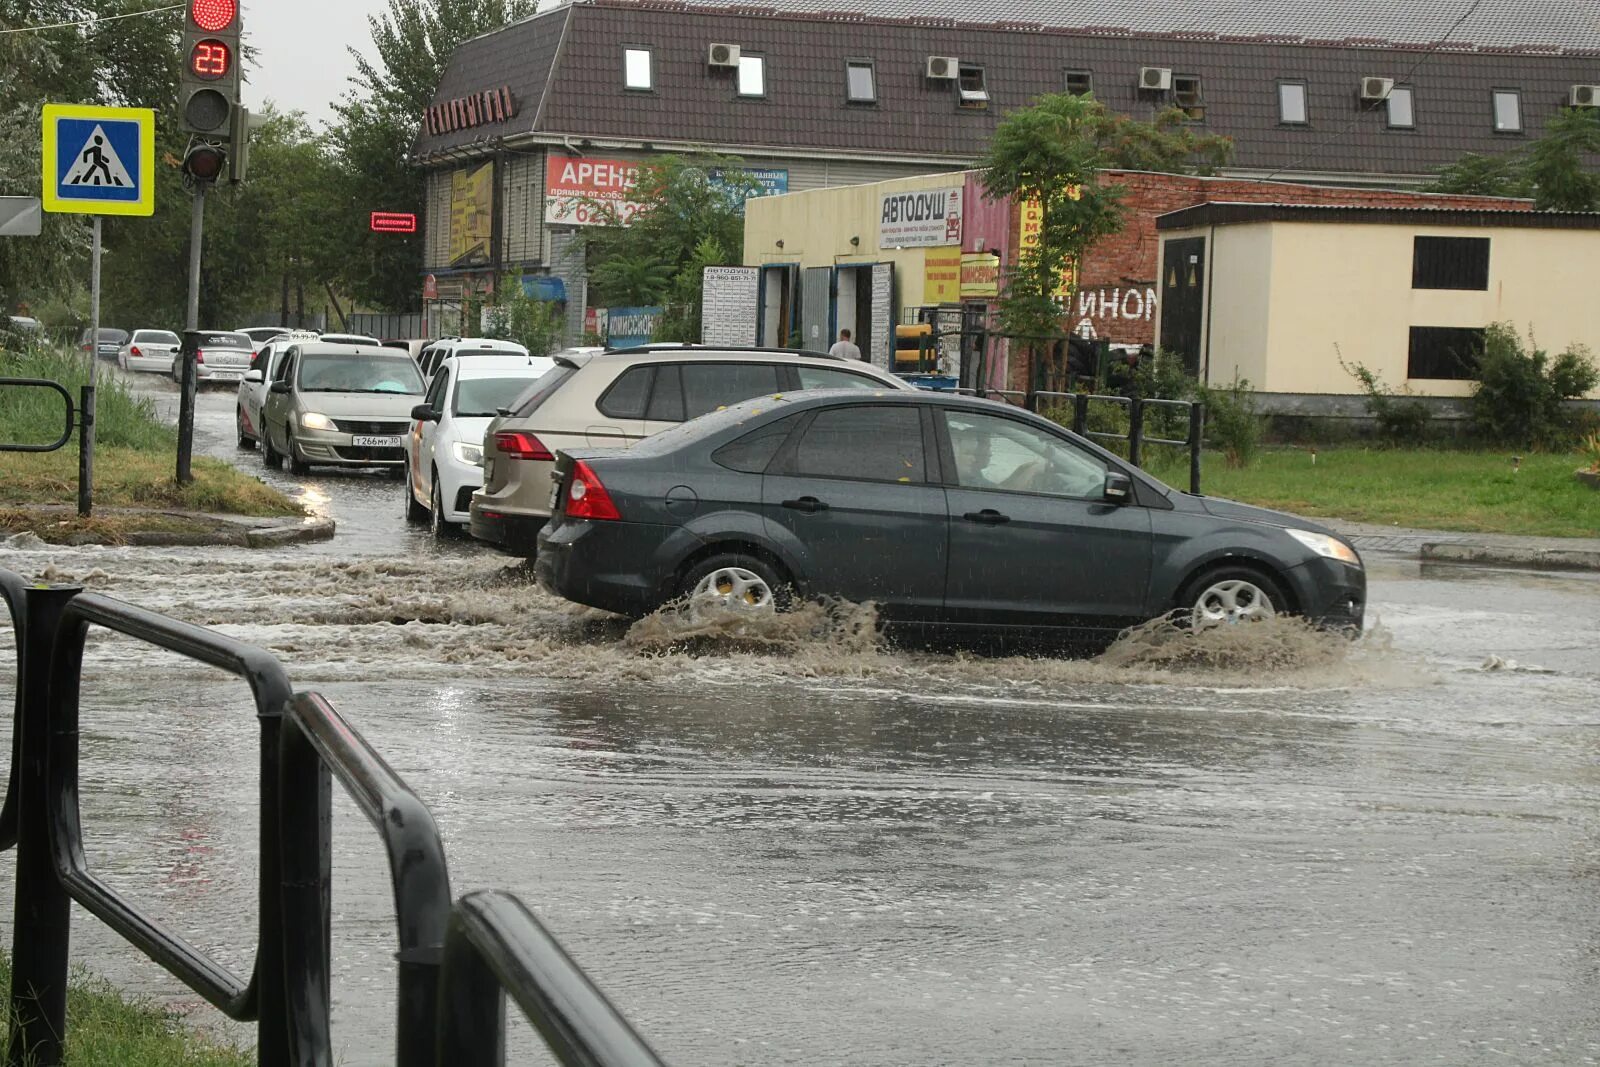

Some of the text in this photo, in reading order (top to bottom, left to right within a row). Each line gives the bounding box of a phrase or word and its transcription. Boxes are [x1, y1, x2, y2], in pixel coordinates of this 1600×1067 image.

[196, 45, 225, 73] 23
[423, 85, 513, 136] ТЕХНОВЫГОДА
[550, 188, 585, 199] прямая
[588, 190, 599, 198] от
[881, 192, 945, 224] АВТОДУШ
